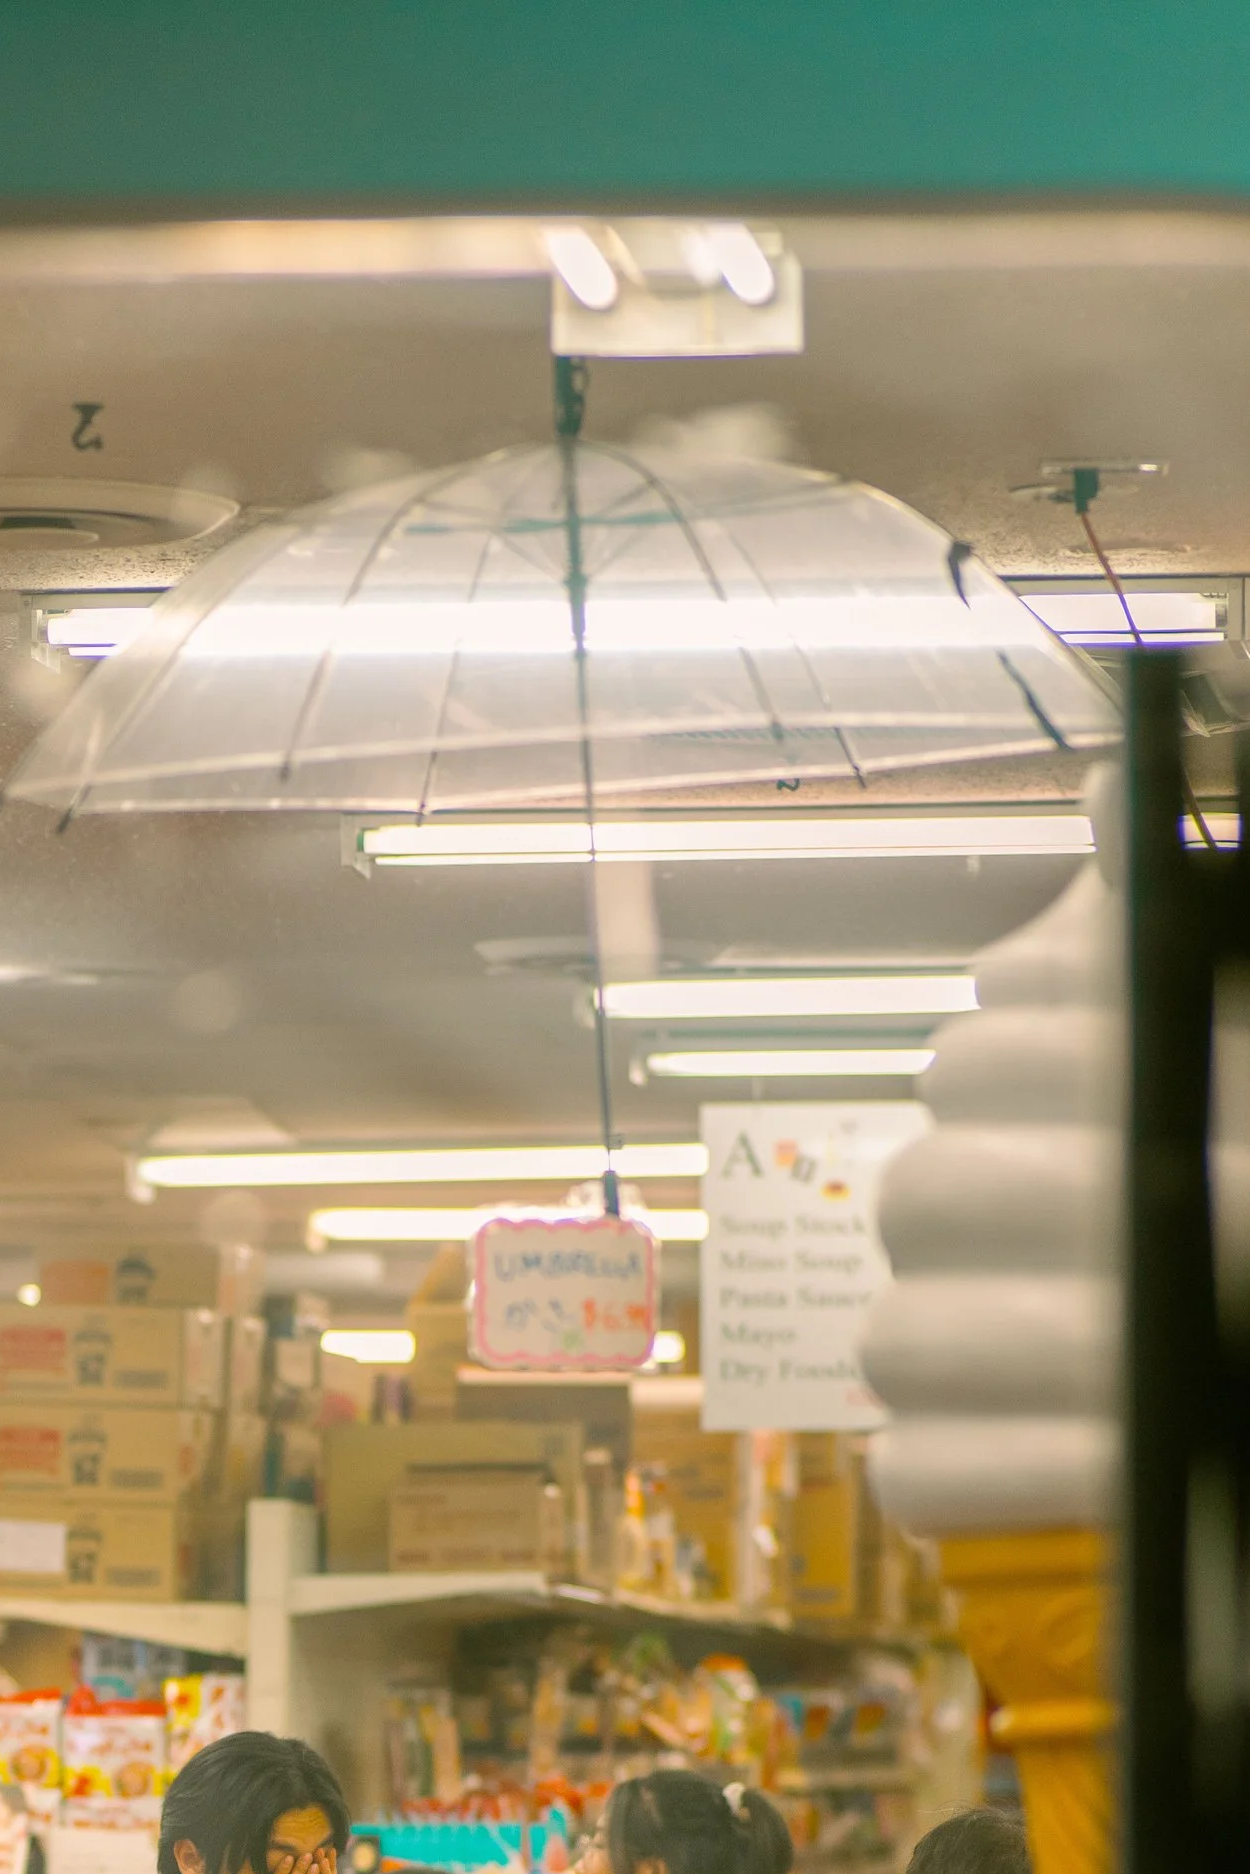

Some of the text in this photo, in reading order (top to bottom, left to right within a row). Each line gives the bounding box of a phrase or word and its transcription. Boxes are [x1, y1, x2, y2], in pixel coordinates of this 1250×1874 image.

[721, 1132, 763, 1180] A
[721, 1214, 787, 1241] Soup
[721, 1250, 865, 1277] Miso Soup
[721, 1287, 788, 1308] Pasta
[721, 1322, 796, 1350] Mayo
[720, 1360, 768, 1388] Dry
